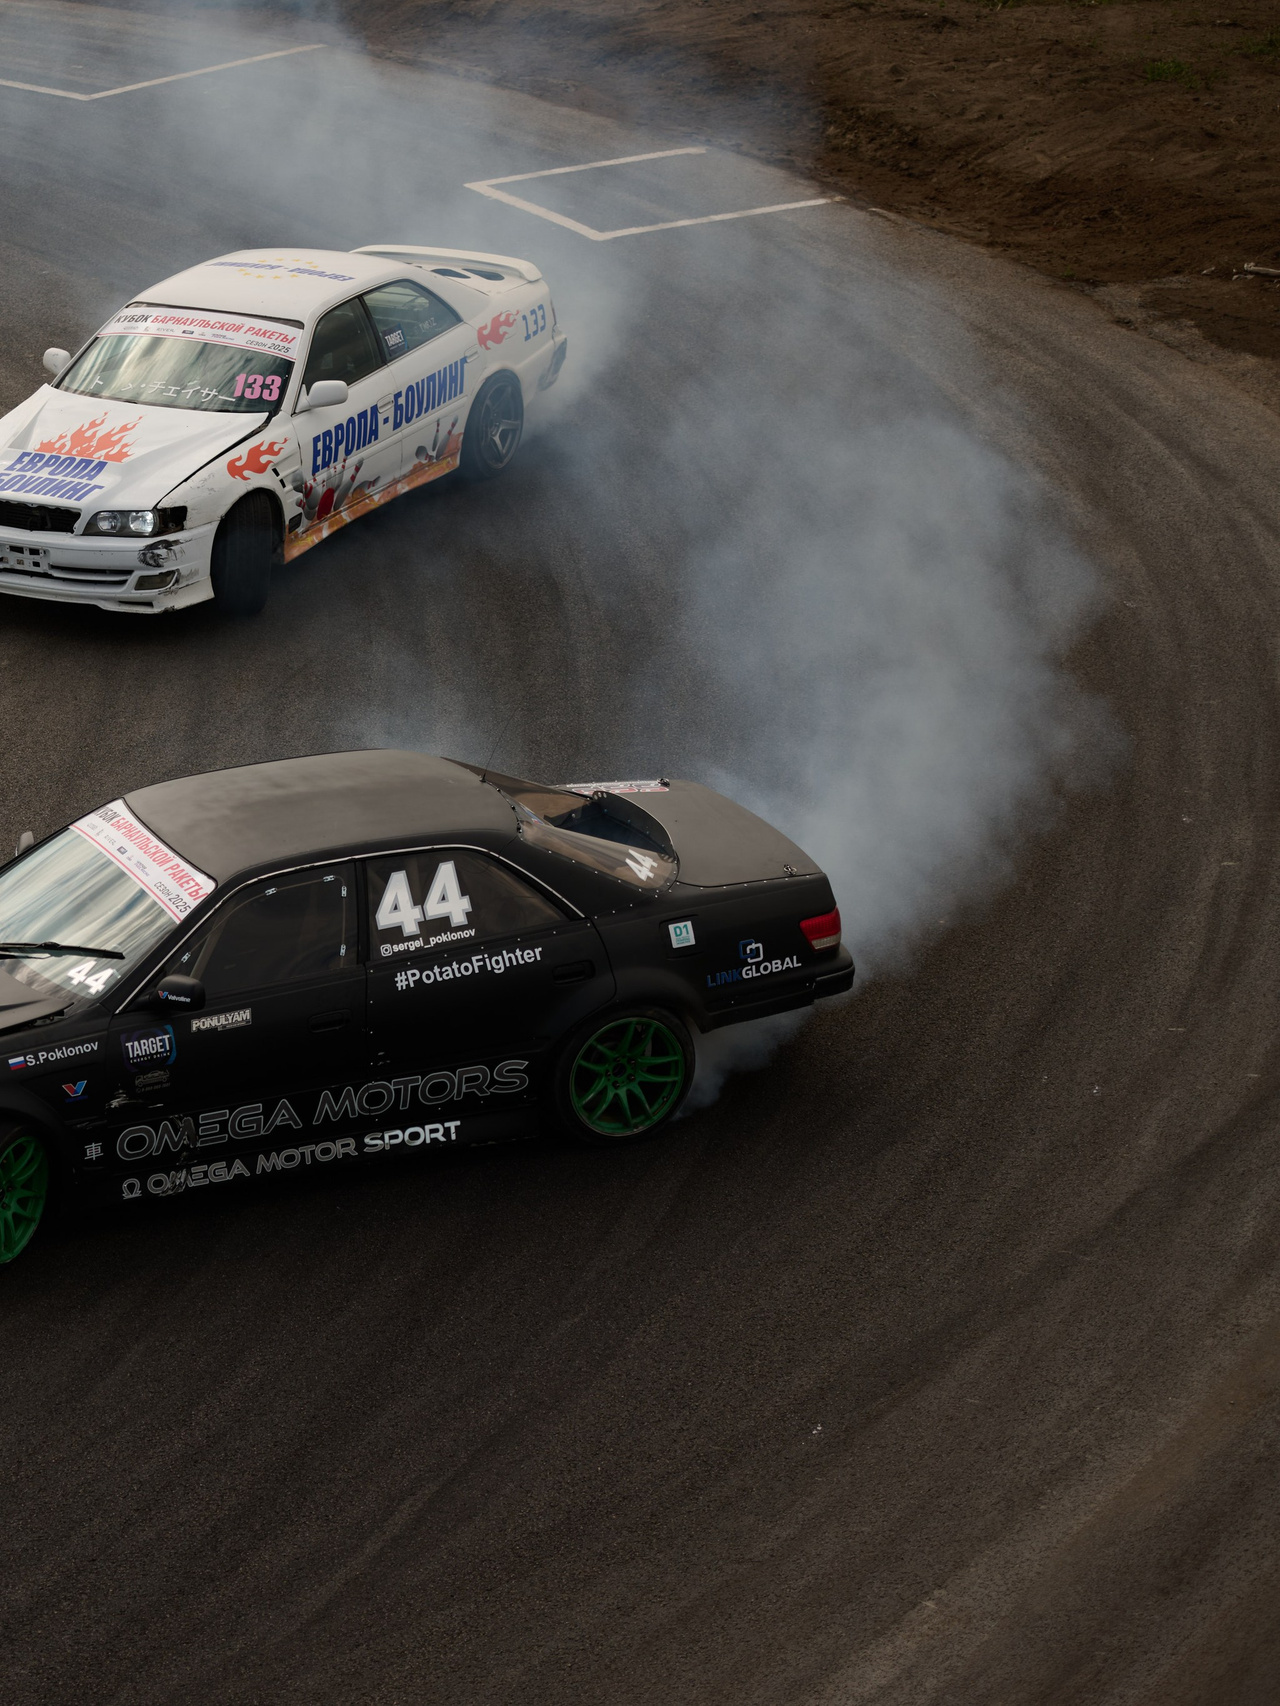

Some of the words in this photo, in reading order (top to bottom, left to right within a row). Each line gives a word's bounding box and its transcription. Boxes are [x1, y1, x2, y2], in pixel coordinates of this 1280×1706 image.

[287, 267, 356, 282] ЕВРОПА
[114, 314, 153, 324] КУБОК
[151, 314, 244, 333] БАРНАУЛЬСКОЙ
[244, 326, 297, 345] РАКЕТЫ
[522, 304, 547, 342] 133
[245, 339, 268, 348] СЕЗОН
[267, 342, 291, 354] 2025
[234, 373, 282, 401] 133
[311, 404, 379, 477] ЕВРОПА
[392, 355, 468, 431] БОУЛИНГ
[4, 451, 108, 481] ЕВРОПА
[110, 817, 177, 868] БАРНАУЛЬСКОЙ
[163, 863, 209, 901] РАКЕТЫ
[625, 849, 658, 882] 44
[154, 881, 173, 898] СЕЗОН
[168, 894, 192, 913] 2025
[375, 860, 473, 937] 44
[392, 928, 476, 953] sergei_poklonov
[673, 924, 690, 938] D1
[66, 960, 117, 995] 44
[394, 947, 543, 991] #PotatoFighter
[167, 993, 191, 1003] Valvoline
[193, 1009, 250, 1031] PONULYAM
[25, 1041, 99, 1067] S.Poklonov
[125, 1034, 171, 1058] TARGET
[130, 1055, 151, 1064] ENERGY
[153, 1051, 171, 1059] DRINK
[116, 1098, 303, 1161] OMEGA
[312, 1059, 530, 1126] MOTORS
[84, 1142, 104, 1160] 車
[147, 1159, 252, 1194] OMEGA
[255, 1136, 358, 1175] MOTOR
[363, 1120, 461, 1154] SPORT
